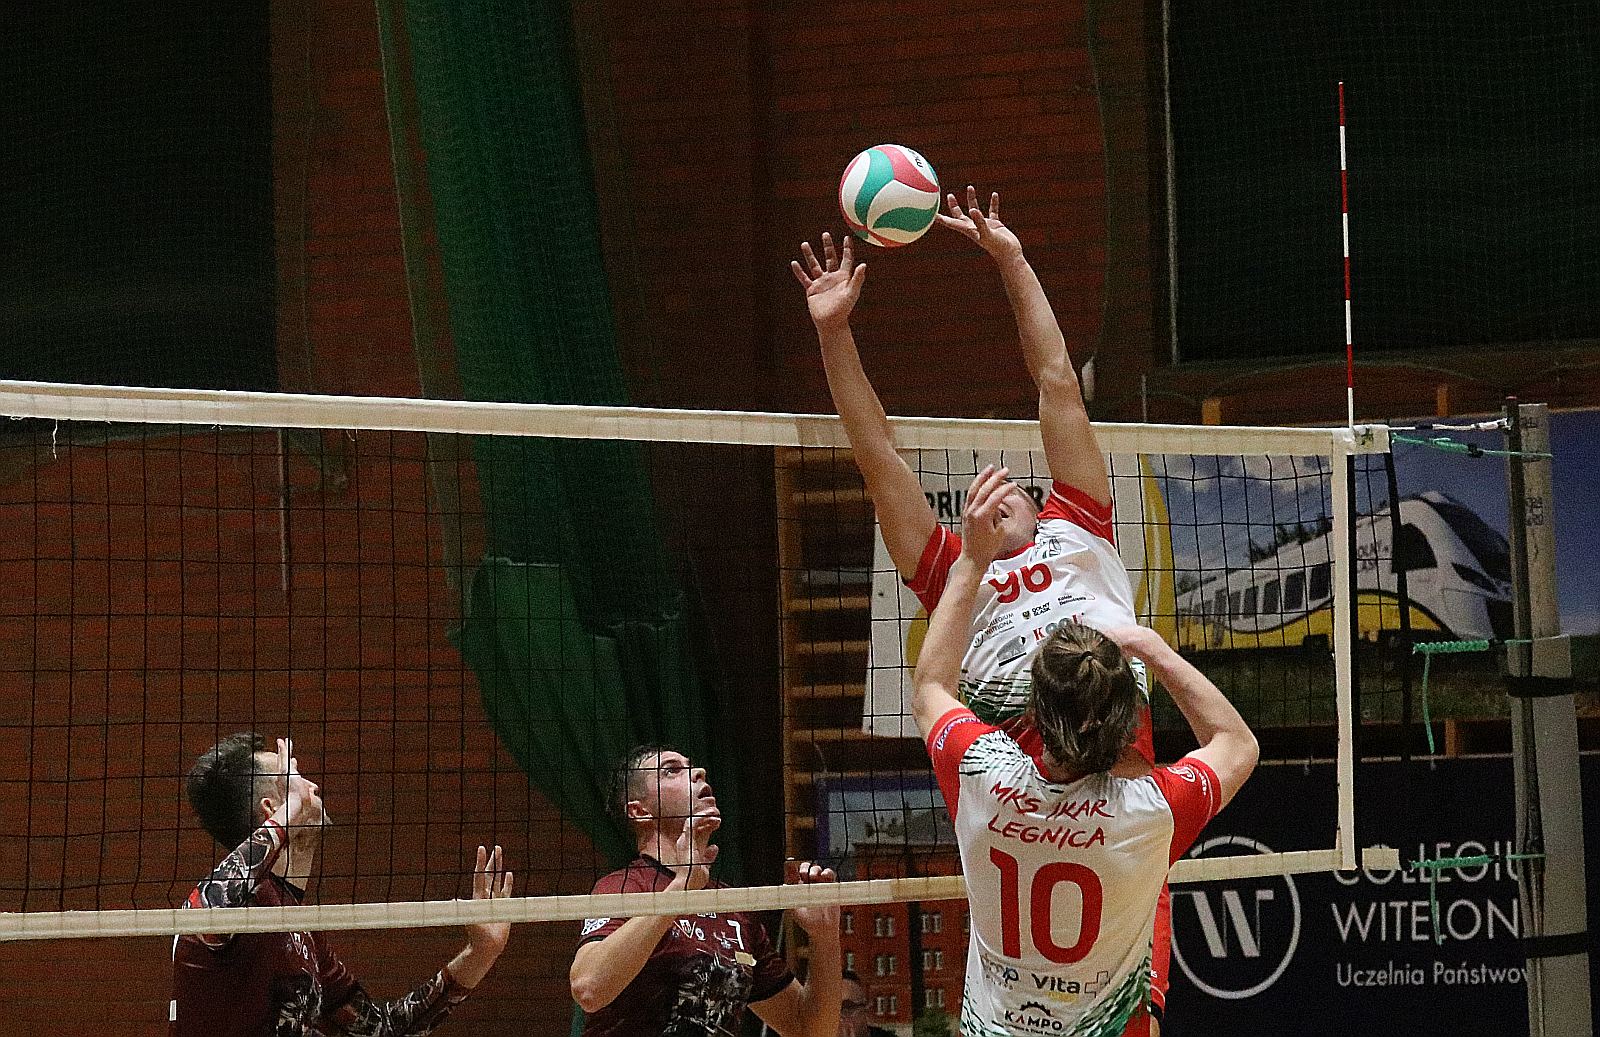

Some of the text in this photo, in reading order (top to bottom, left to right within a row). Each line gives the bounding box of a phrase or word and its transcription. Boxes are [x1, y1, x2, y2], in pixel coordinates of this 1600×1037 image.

[990, 781, 1115, 821] MKS IKAR
[988, 813, 1105, 850] LEGNICA
[990, 846, 1103, 964] 10
[1337, 961, 1424, 987] Uczelnia
[1004, 1010, 1063, 1031] KAMPO
